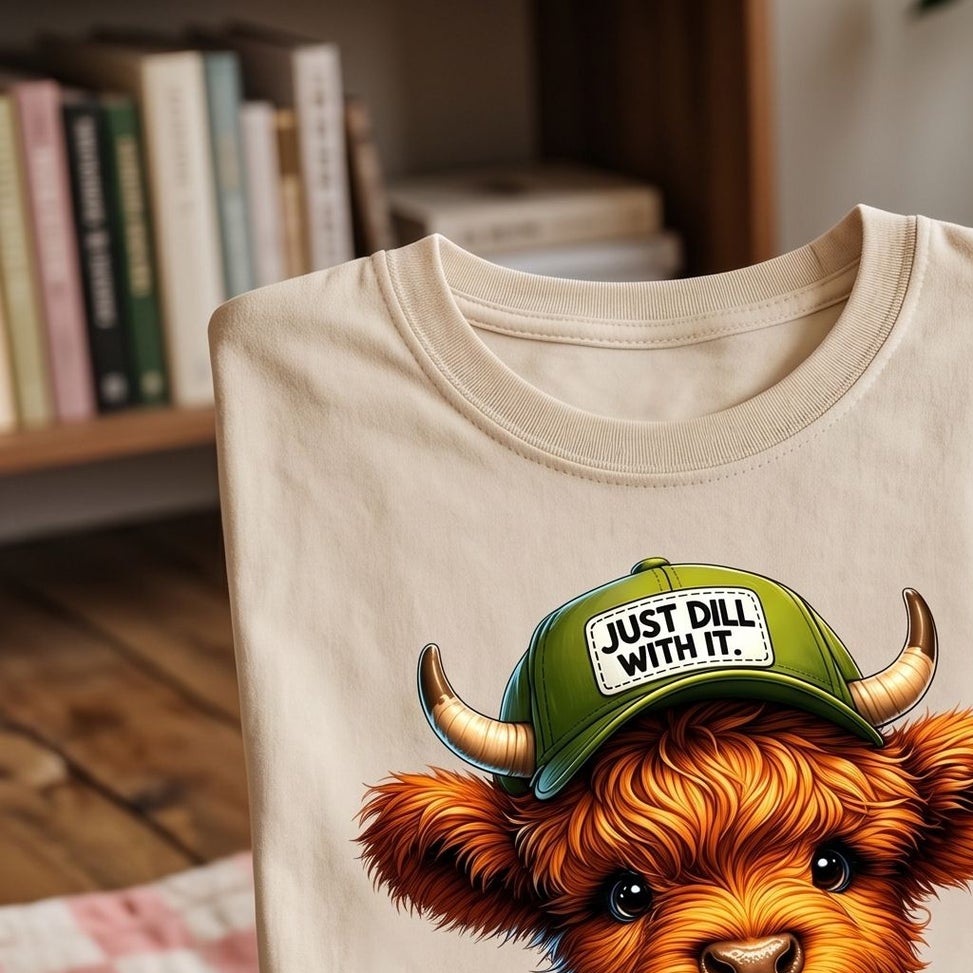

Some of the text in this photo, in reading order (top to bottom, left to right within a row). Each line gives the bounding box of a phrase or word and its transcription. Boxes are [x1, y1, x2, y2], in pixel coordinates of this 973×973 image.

[601, 599, 755, 654] JUST DILL
[617, 630, 742, 676] WITH IT.
